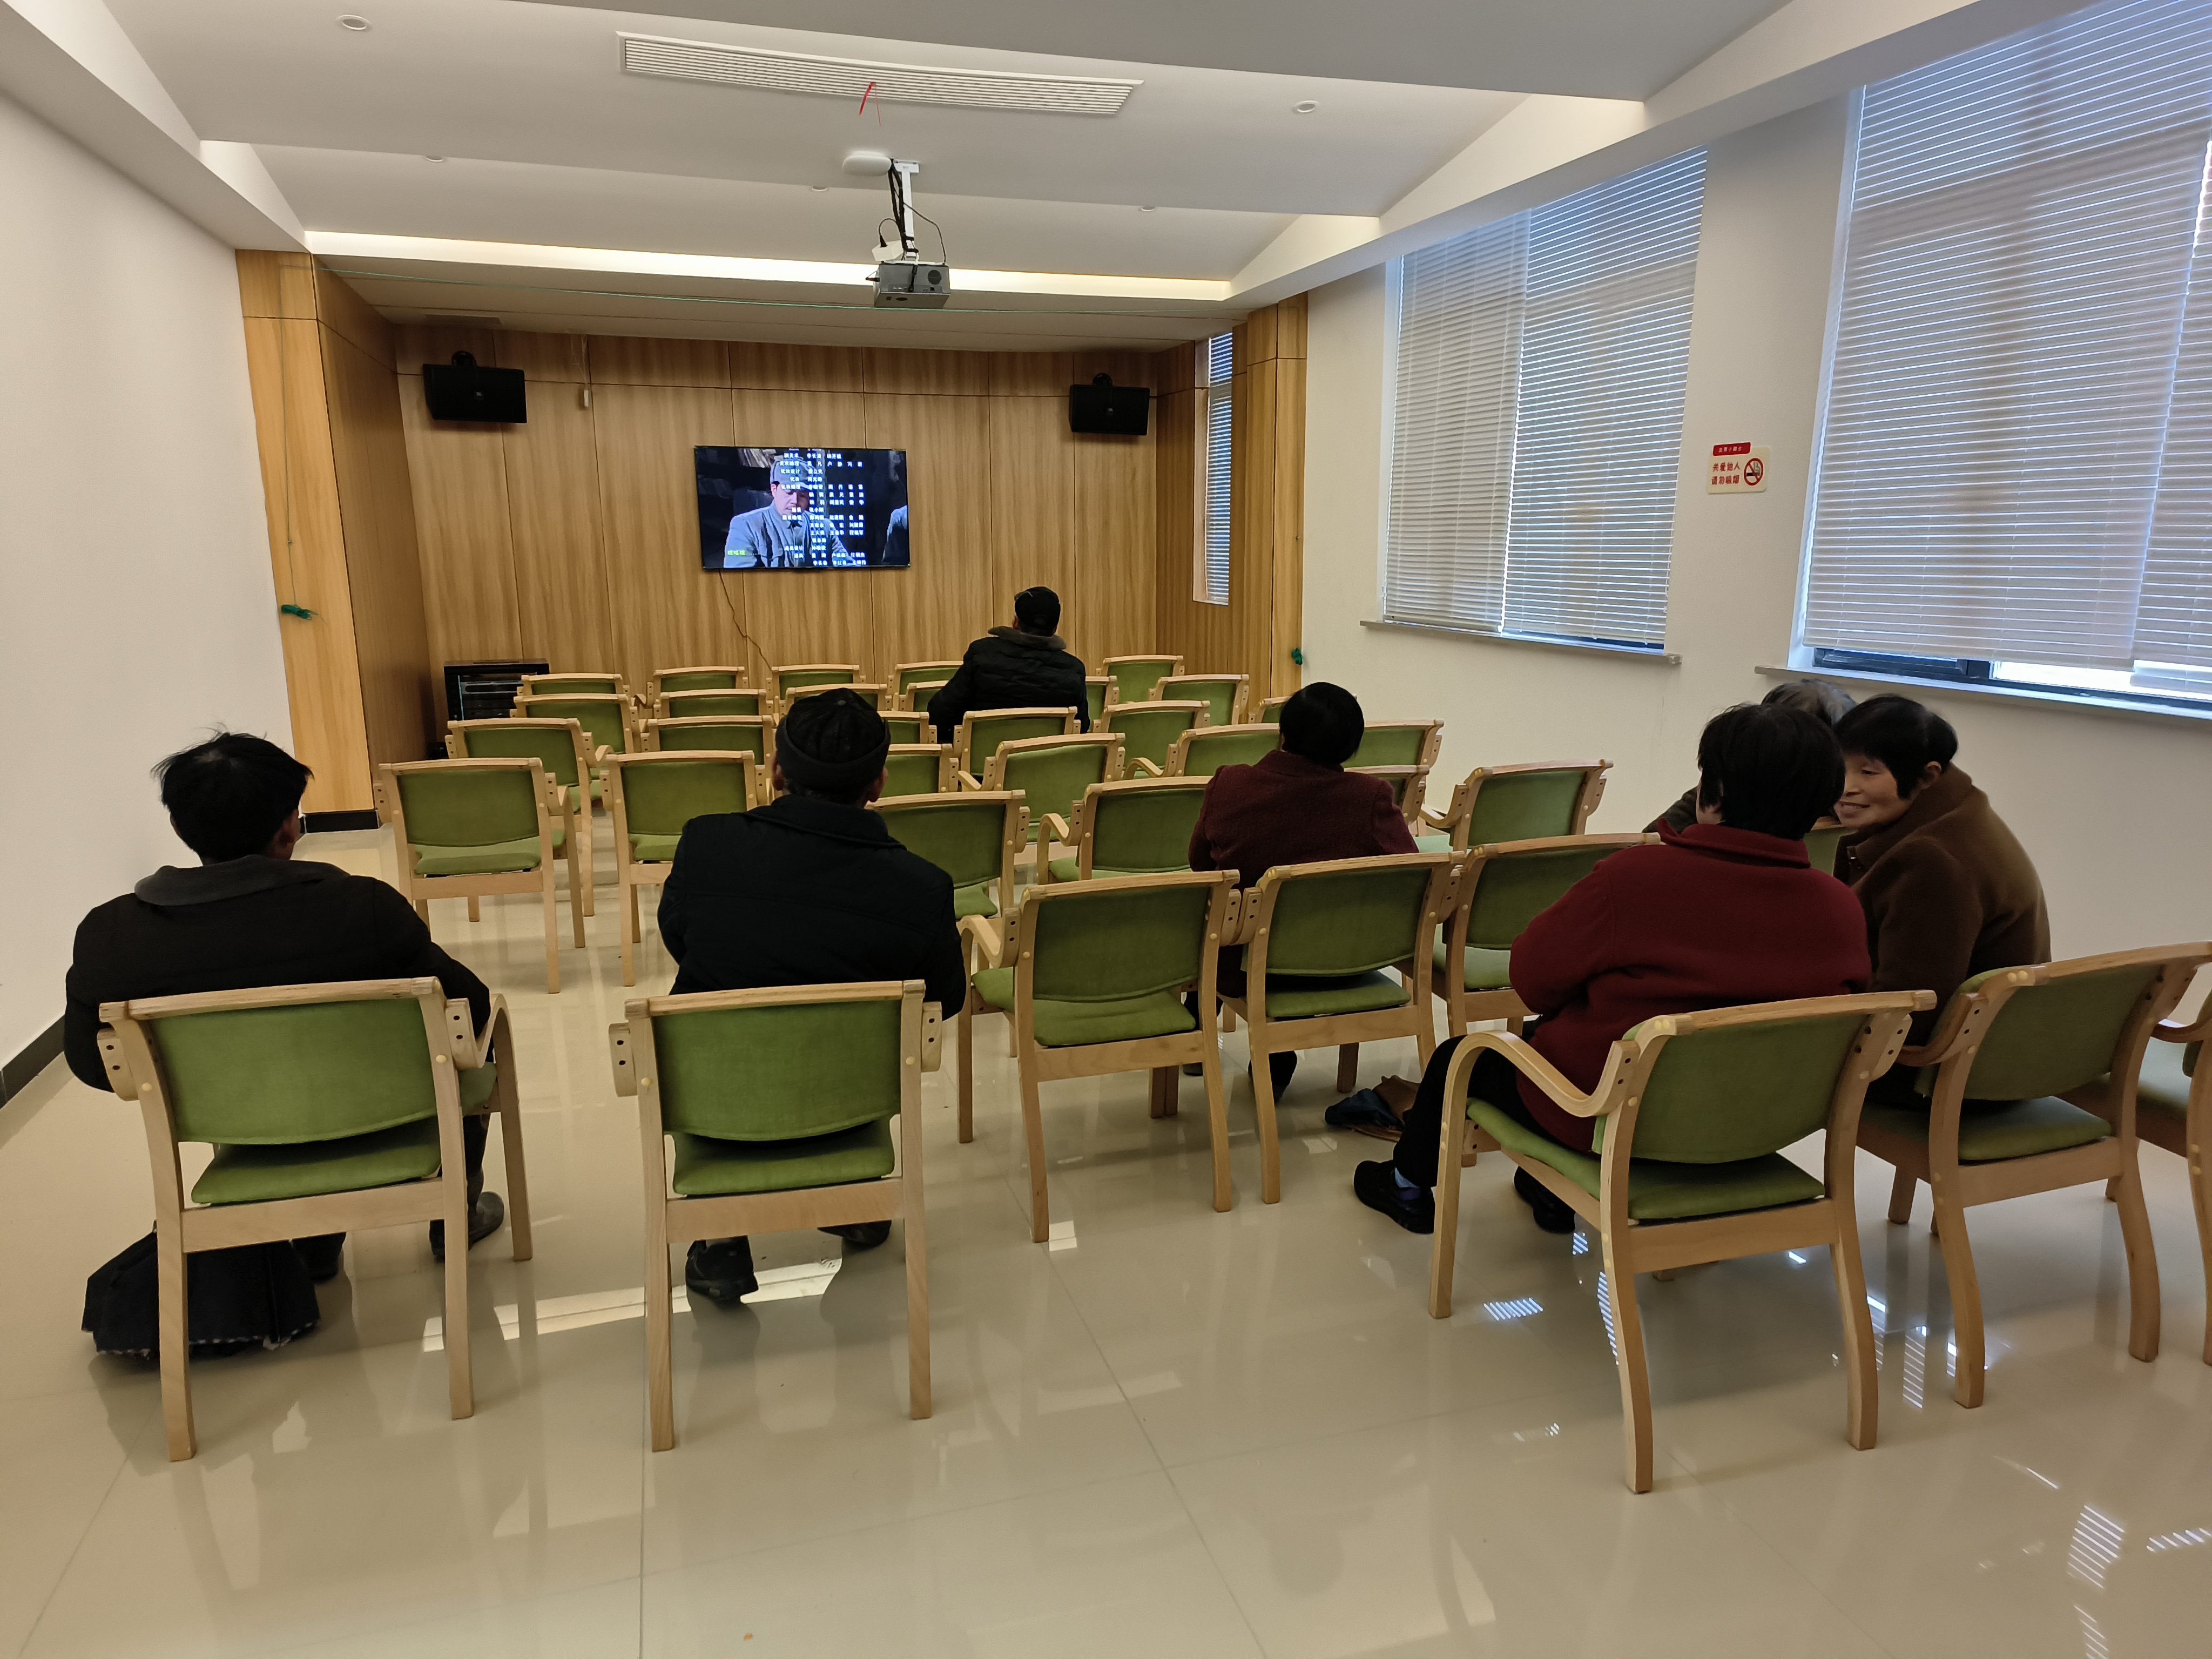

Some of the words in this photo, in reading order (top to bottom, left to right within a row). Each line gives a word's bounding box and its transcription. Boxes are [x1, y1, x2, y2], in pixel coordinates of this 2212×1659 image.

[1712, 462, 1740, 472] 关爱他人
[1711, 475, 1739, 485] 请勿吸烟
